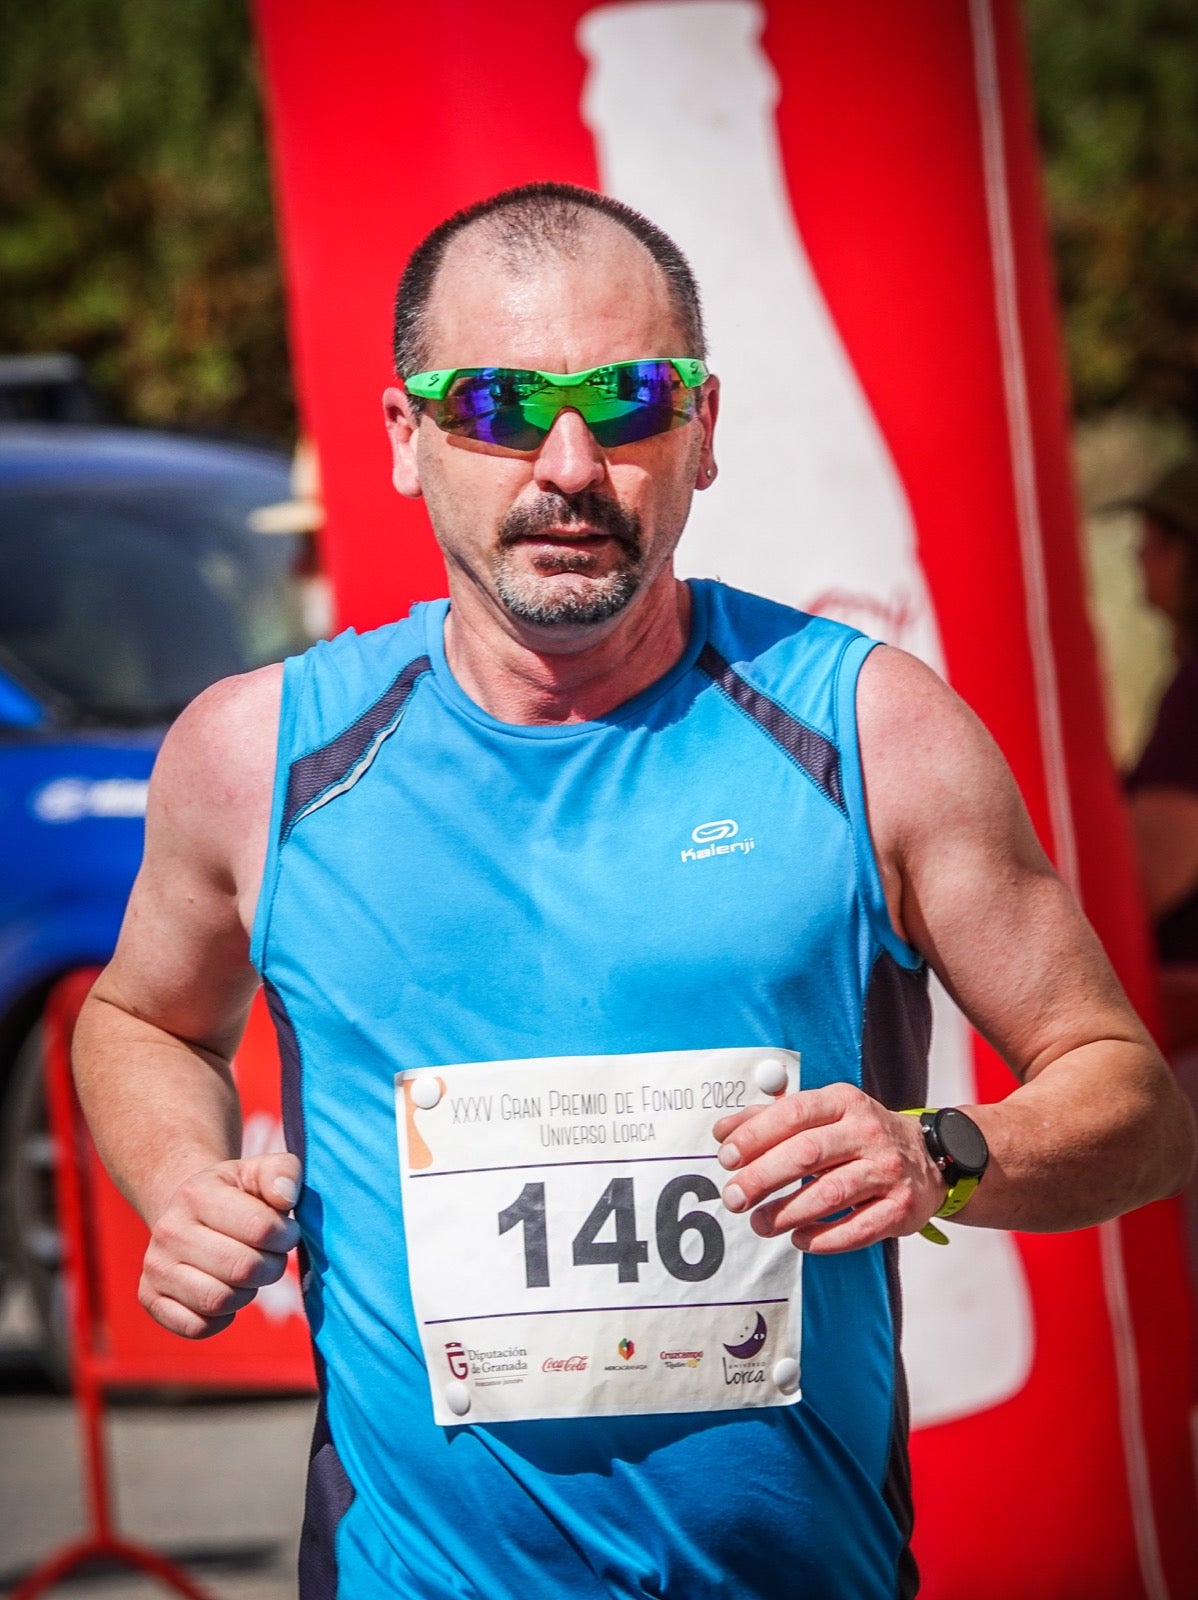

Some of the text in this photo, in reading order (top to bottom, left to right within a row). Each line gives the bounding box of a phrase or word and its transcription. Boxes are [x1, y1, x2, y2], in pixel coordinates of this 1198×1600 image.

[450, 1095, 493, 1125] XXXV
[701, 1080, 746, 1109] 2022
[498, 1174, 725, 1289] 146
[467, 1346, 528, 1362] Diputación
[481, 1359, 528, 1374] Granada
